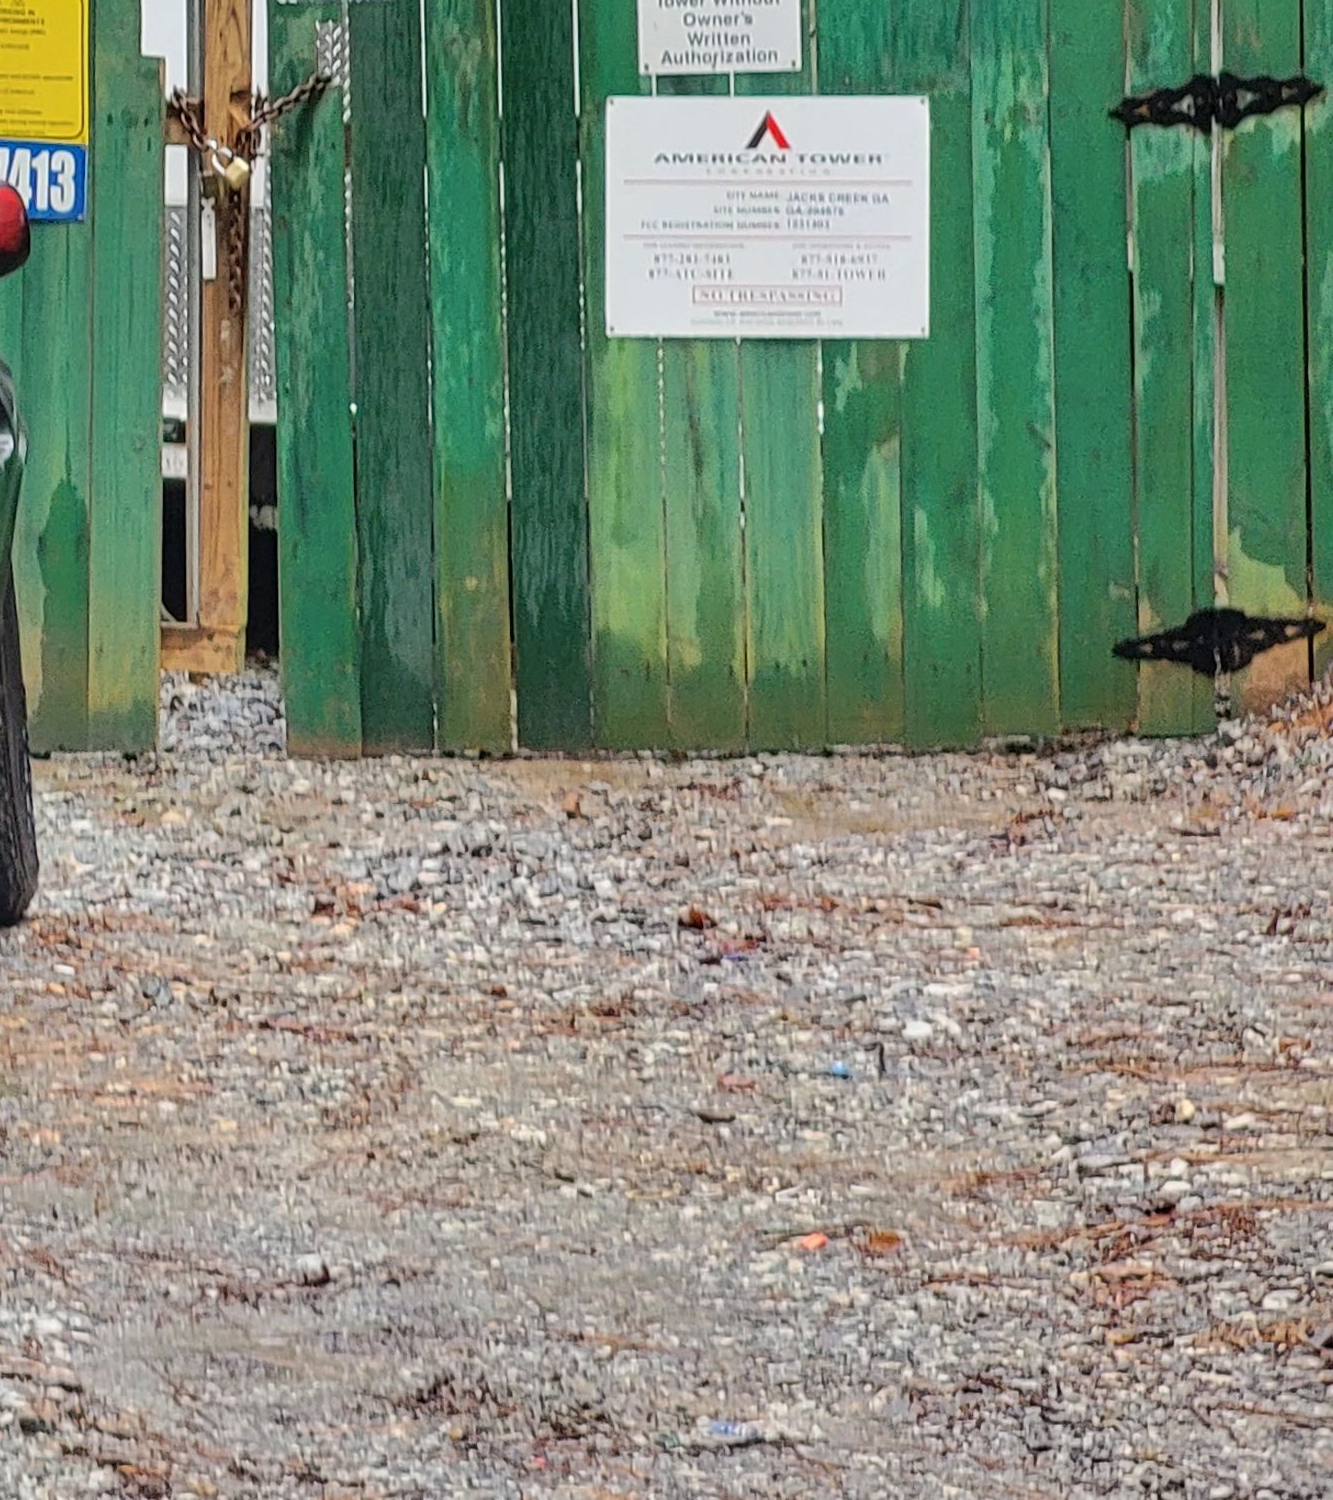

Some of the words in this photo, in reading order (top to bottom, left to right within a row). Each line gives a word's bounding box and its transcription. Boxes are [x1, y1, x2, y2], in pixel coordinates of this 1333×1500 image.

[683, 11, 754, 27] Owner's
[687, 31, 751, 47] Written
[661, 49, 778, 66] Authorization
[654, 153, 787, 165] AMERICAN
[797, 153, 882, 165] TOWER
